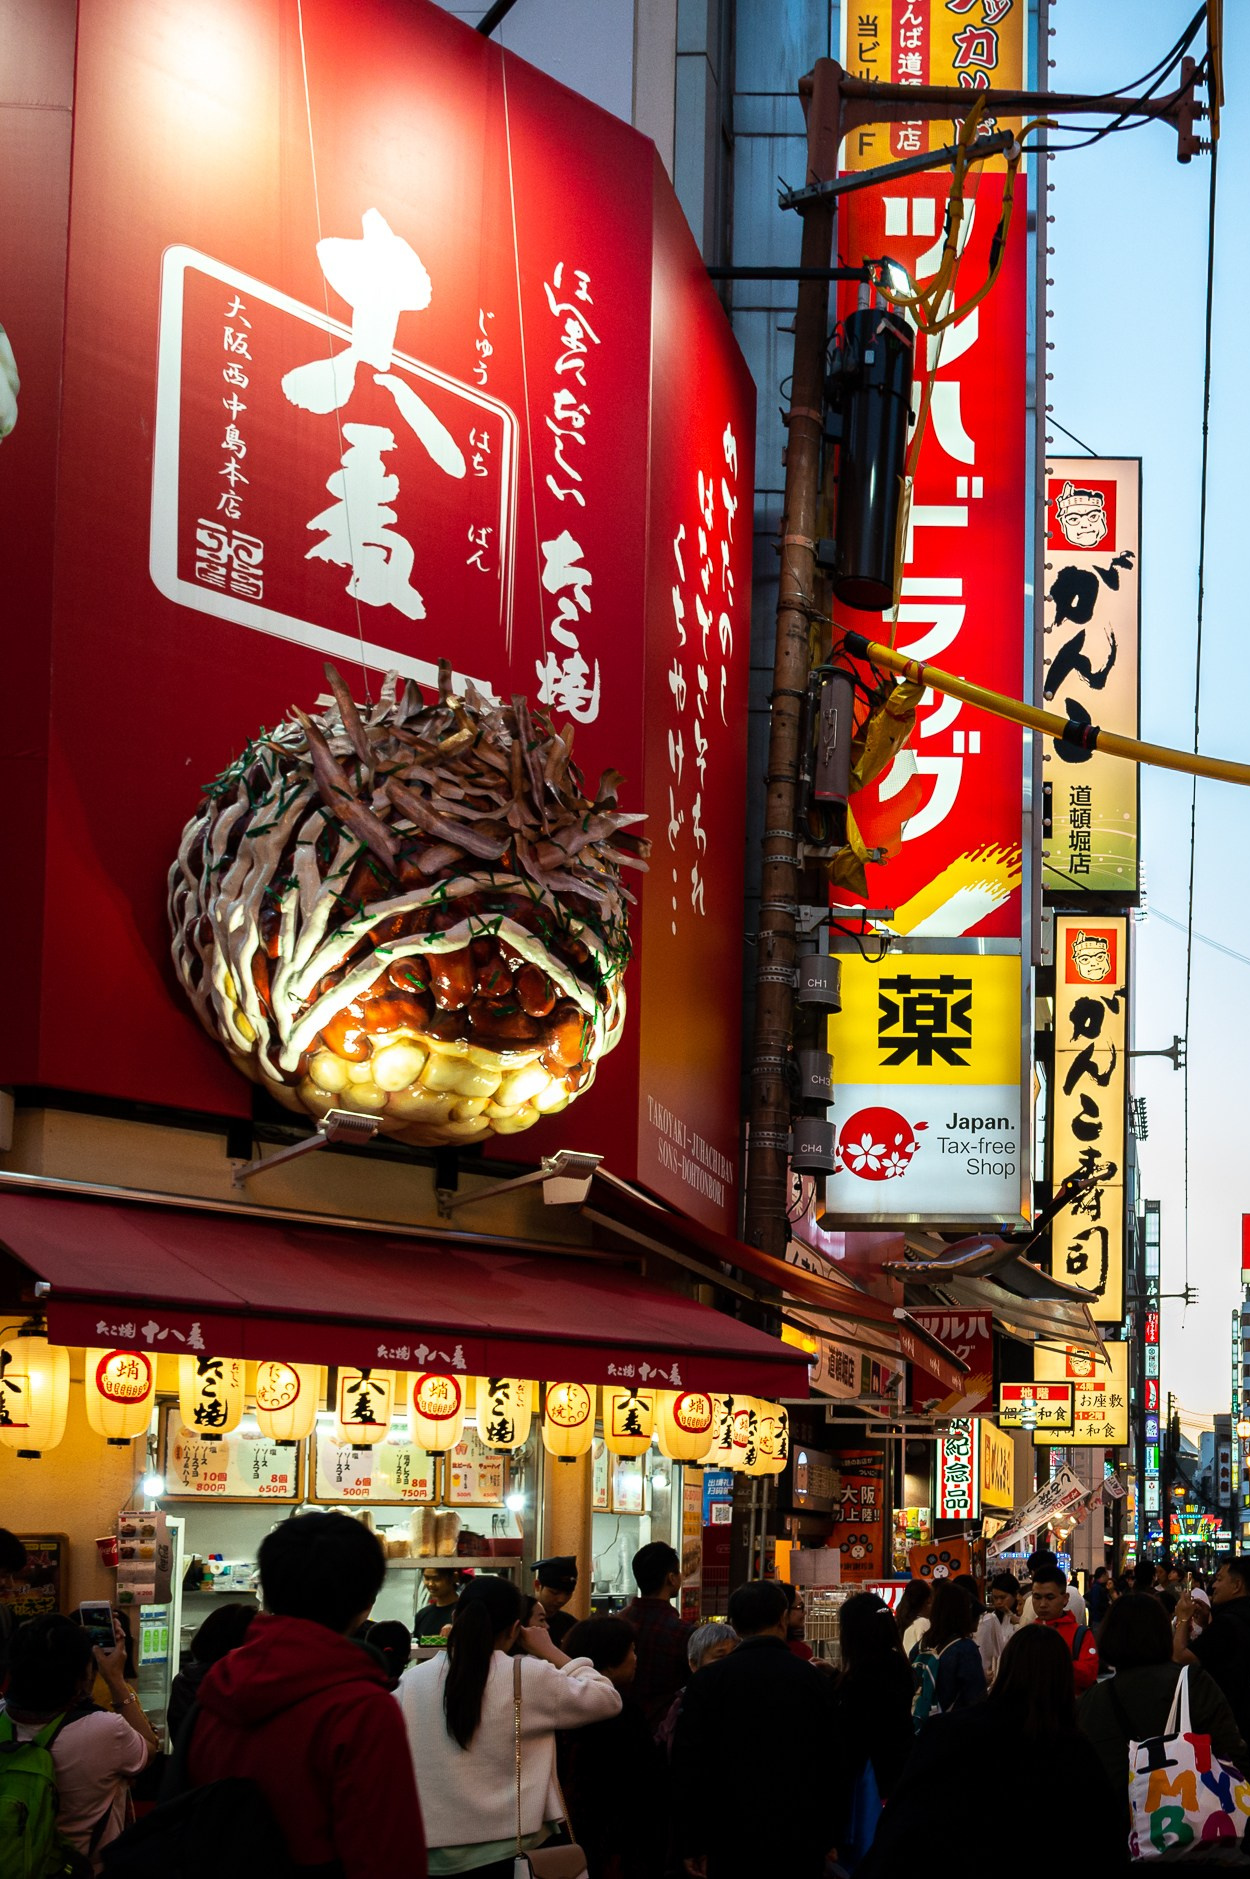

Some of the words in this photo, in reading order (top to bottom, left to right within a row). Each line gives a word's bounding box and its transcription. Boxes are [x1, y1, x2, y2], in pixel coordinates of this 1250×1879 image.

[216, 294, 253, 520] 大阪西中島本店
[469, 426, 491, 478] はち
[465, 523, 491, 573] ばん
[1068, 784, 1092, 875] 道頓堀店
[807, 978, 828, 988] CH1
[878, 974, 972, 1066] 薬
[811, 1074, 832, 1084] CH3
[946, 1112, 1015, 1132] Japan.
[801, 1144, 823, 1153] CH4
[937, 1137, 1016, 1154] Tax-free
[966, 1158, 1016, 1178] Shop
[1020, 1387, 1049, 1399] 地階
[203, 1472, 227, 1482] 10個
[270, 1474, 288, 1483] 8個
[355, 1477, 371, 1487] 6個
[196, 1483, 226, 1492] 800円
[411, 1479, 427, 1488] 8個
[258, 1485, 287, 1493] 650円
[343, 1488, 370, 1497] 500円
[401, 1489, 427, 1498] 750円
[840, 1485, 876, 1505] 大阪
